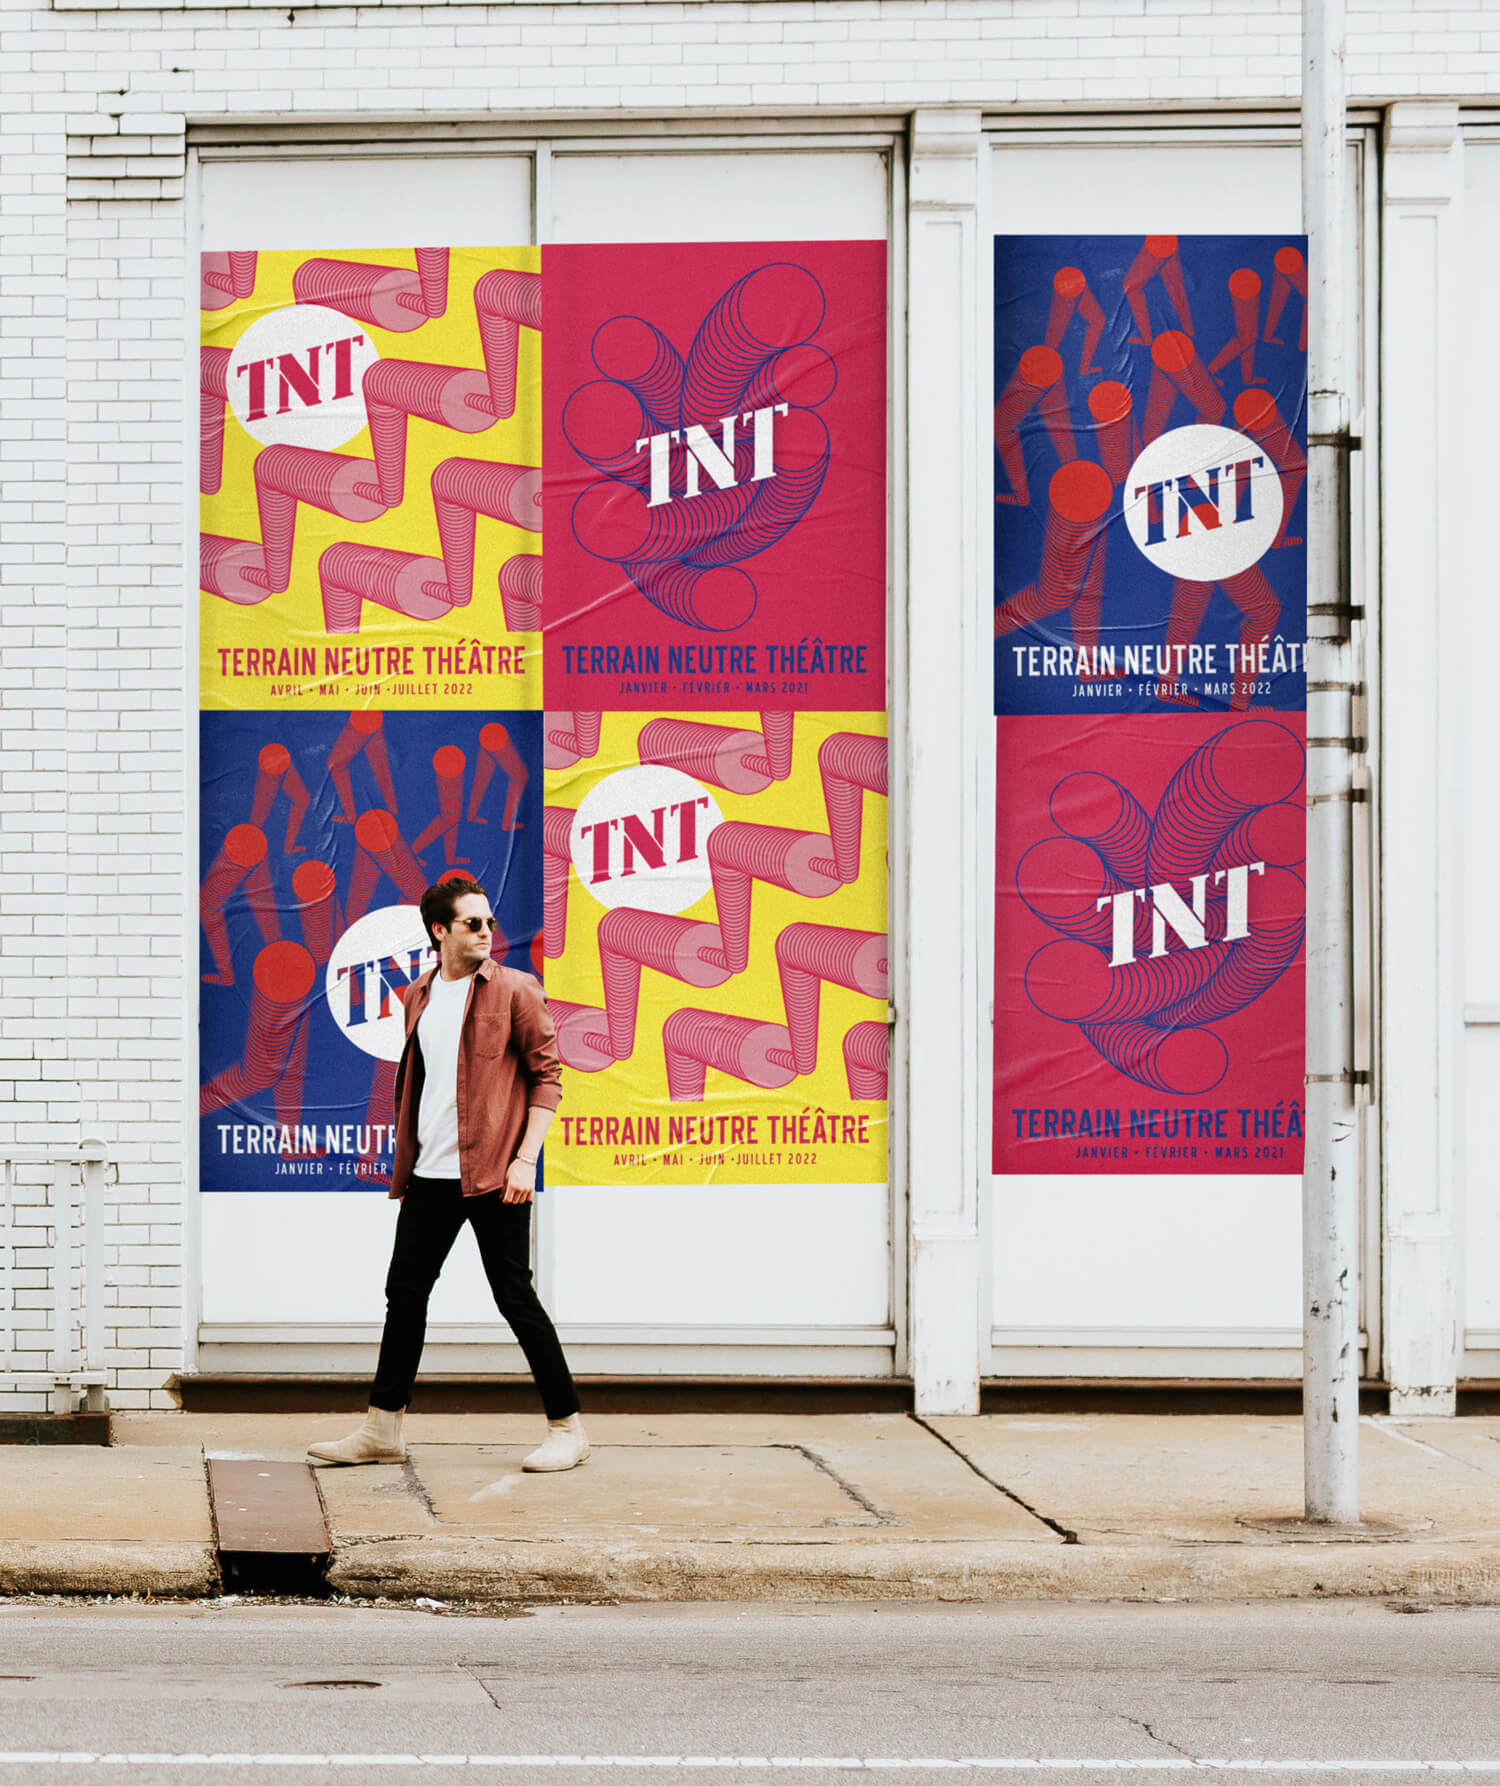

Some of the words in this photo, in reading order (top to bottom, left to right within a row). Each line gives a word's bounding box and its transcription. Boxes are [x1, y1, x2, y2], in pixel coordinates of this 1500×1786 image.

[237, 335, 364, 422] TNT
[636, 403, 788, 508] TNT
[1135, 456, 1263, 546] TNT
[217, 647, 316, 677] TERRAIN
[325, 647, 414, 676] NEUTRE
[423, 638, 526, 675] THÉÂTRE
[562, 645, 660, 674] TERRAIN
[668, 645, 757, 674] NEUTRE
[765, 637, 867, 674] THÉÂTRE
[1012, 645, 1115, 677] TERRAIN
[1124, 643, 1217, 675] NEUTRE
[270, 684, 303, 697] AVRIL
[319, 683, 340, 696] MAI
[354, 683, 381, 696] JUIN
[443, 682, 473, 695] 2022
[620, 681, 667, 694] JANVIER
[682, 679, 730, 694] FÉVRIER
[745, 681, 776, 694] MARS
[781, 681, 808, 694] 2021
[1072, 684, 1123, 697] JANVIER
[1138, 681, 1188, 696] FÉVRIER
[1204, 683, 1235, 695] MARS
[1241, 682, 1271, 695] 2022
[581, 796, 709, 884] TNT
[1097, 861, 1264, 967] TNT
[560, 1116, 660, 1146] TERRAIN
[668, 1115, 759, 1145] NEUTRE
[767, 1106, 870, 1144] THÉÂTRE
[1011, 1109, 1120, 1138] TERRAIN
[1129, 1108, 1228, 1138] NEUTRE
[1236, 1100, 1306, 1138] THÉÂ
[217, 1125, 317, 1155] TERRAIN
[1076, 1146, 1128, 1159] JANVIER
[1145, 1144, 1198, 1159] FÉVRIER
[1215, 1146, 1248, 1159] MARS
[1253, 1146, 1284, 1159] 2021
[274, 1163, 323, 1176] JANVIER
[339, 1160, 387, 1176] FÉVRIER
[613, 1154, 647, 1166] AVRIL
[663, 1153, 684, 1166] MAI
[698, 1153, 725, 1165] JUIN
[788, 1152, 817, 1165] 2022
